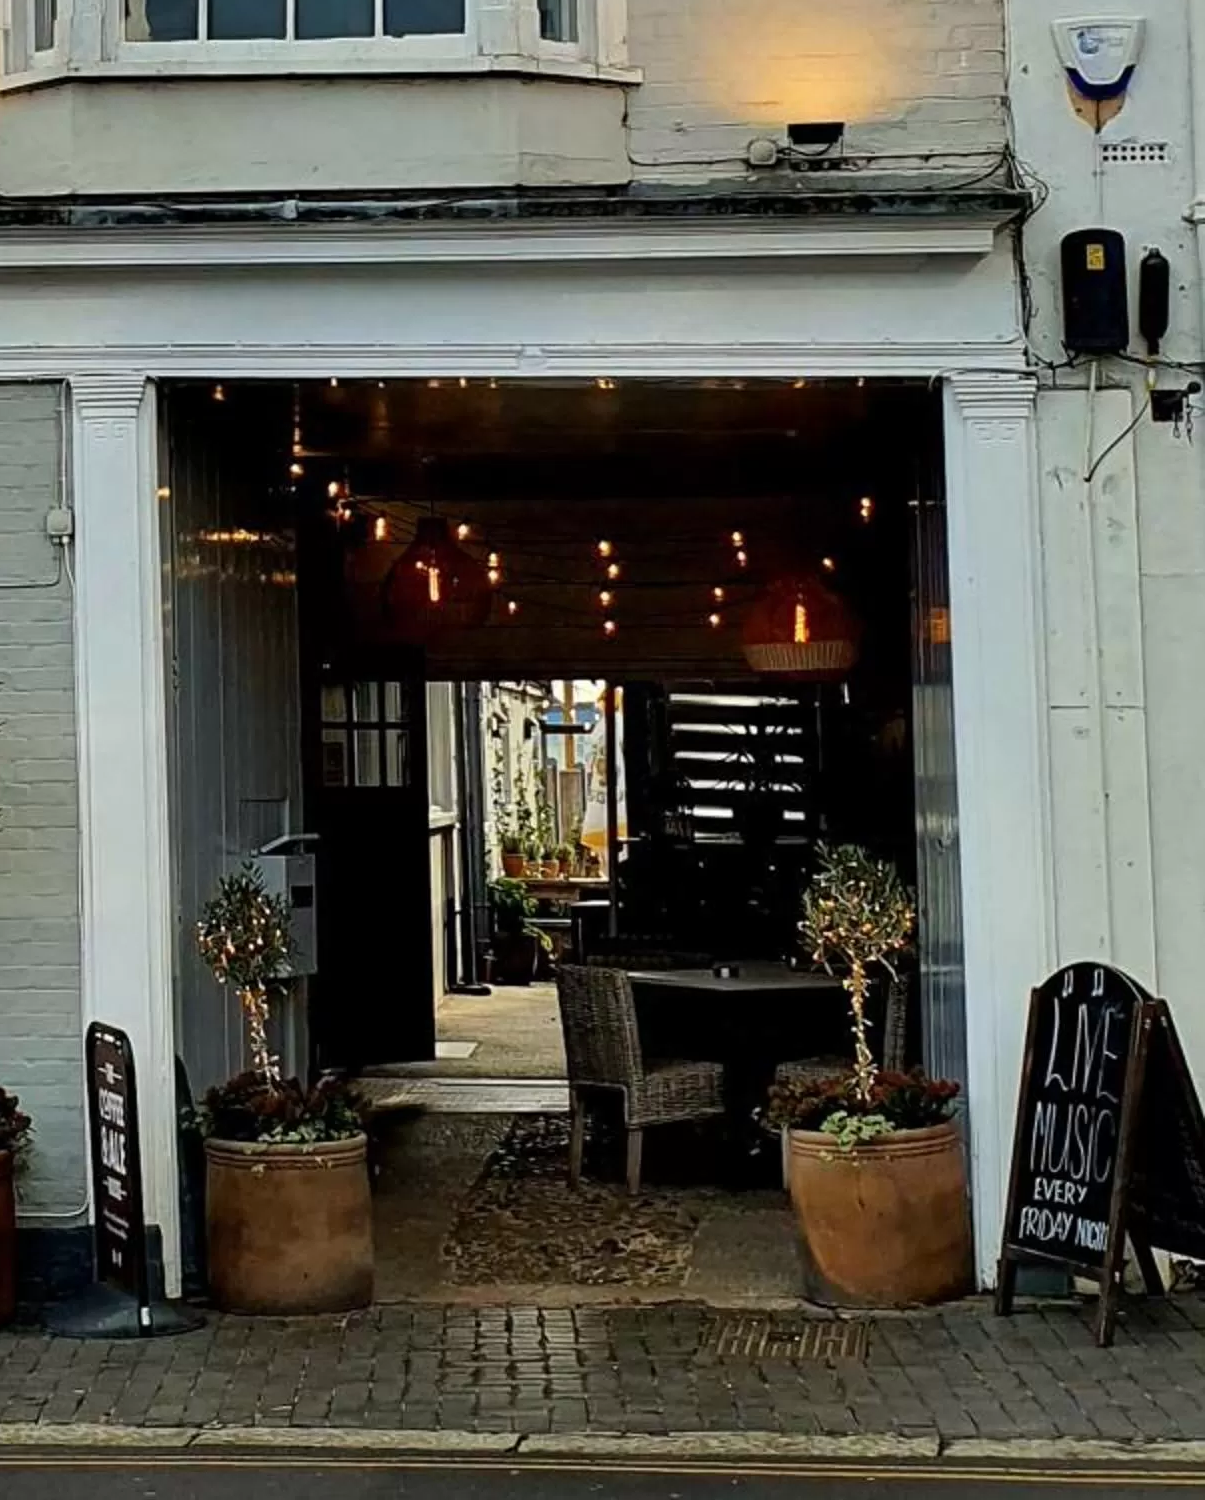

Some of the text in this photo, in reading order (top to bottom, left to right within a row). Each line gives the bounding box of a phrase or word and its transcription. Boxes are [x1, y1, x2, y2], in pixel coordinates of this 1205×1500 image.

[1045, 997, 1124, 1104] LIVE
[1030, 1100, 1116, 1182] MUSIC
[1033, 1176, 1088, 1206] EVERY
[1018, 1205, 1074, 1241] FRIDAY
